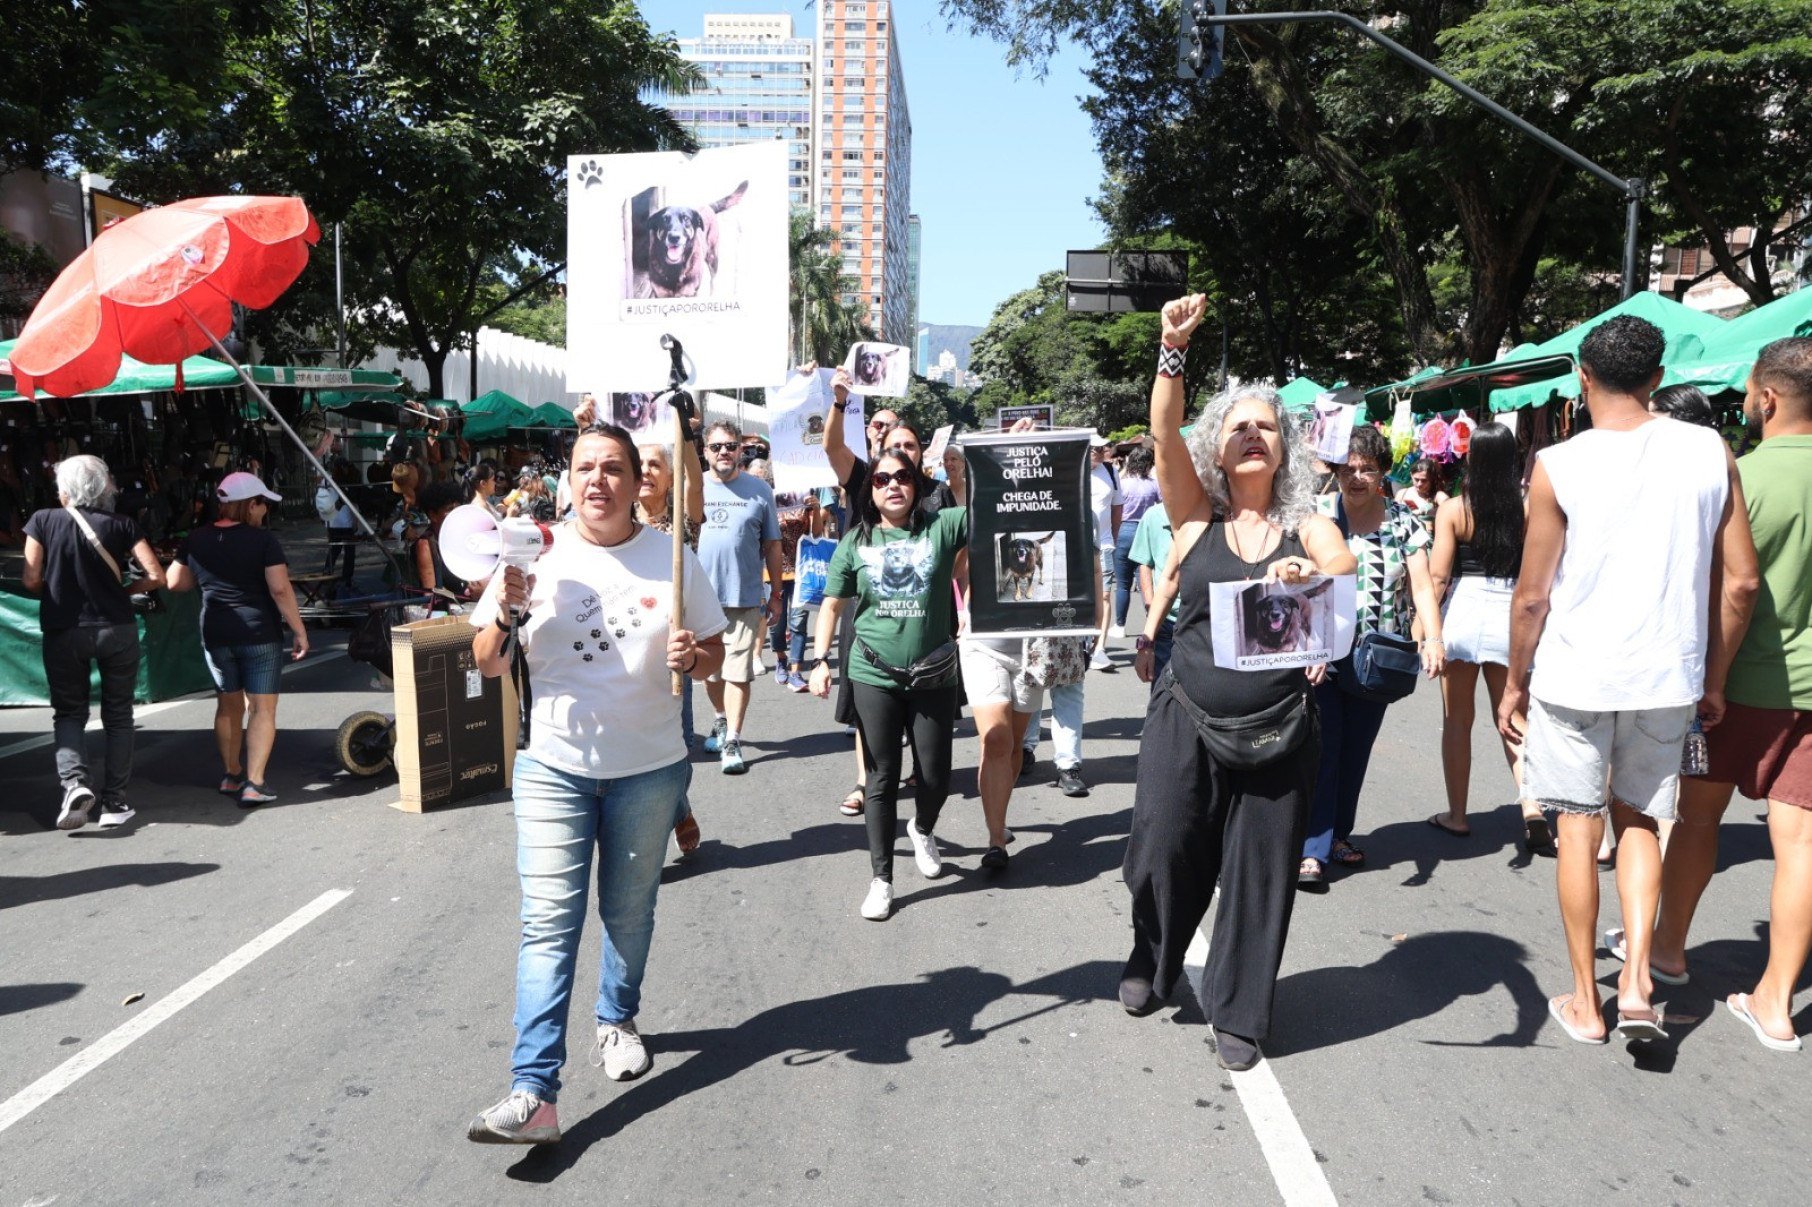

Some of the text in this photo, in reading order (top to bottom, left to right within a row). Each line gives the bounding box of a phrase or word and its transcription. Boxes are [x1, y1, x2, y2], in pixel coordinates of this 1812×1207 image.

[627, 301, 741, 317] #JUSTIÇAPORORELHA
[1007, 446, 1048, 458] JUSTIÇA
[1014, 457, 1041, 467] PELO
[1003, 466, 1052, 479] ORELHA!
[1003, 490, 1052, 502] CHEGA DE
[996, 500, 1062, 513] IMPUNIDADE.
[576, 605, 602, 623] Quem
[890, 609, 926, 617] ORELHA
[1241, 652, 1328, 665] #JUSTIÇAPORORELHA
